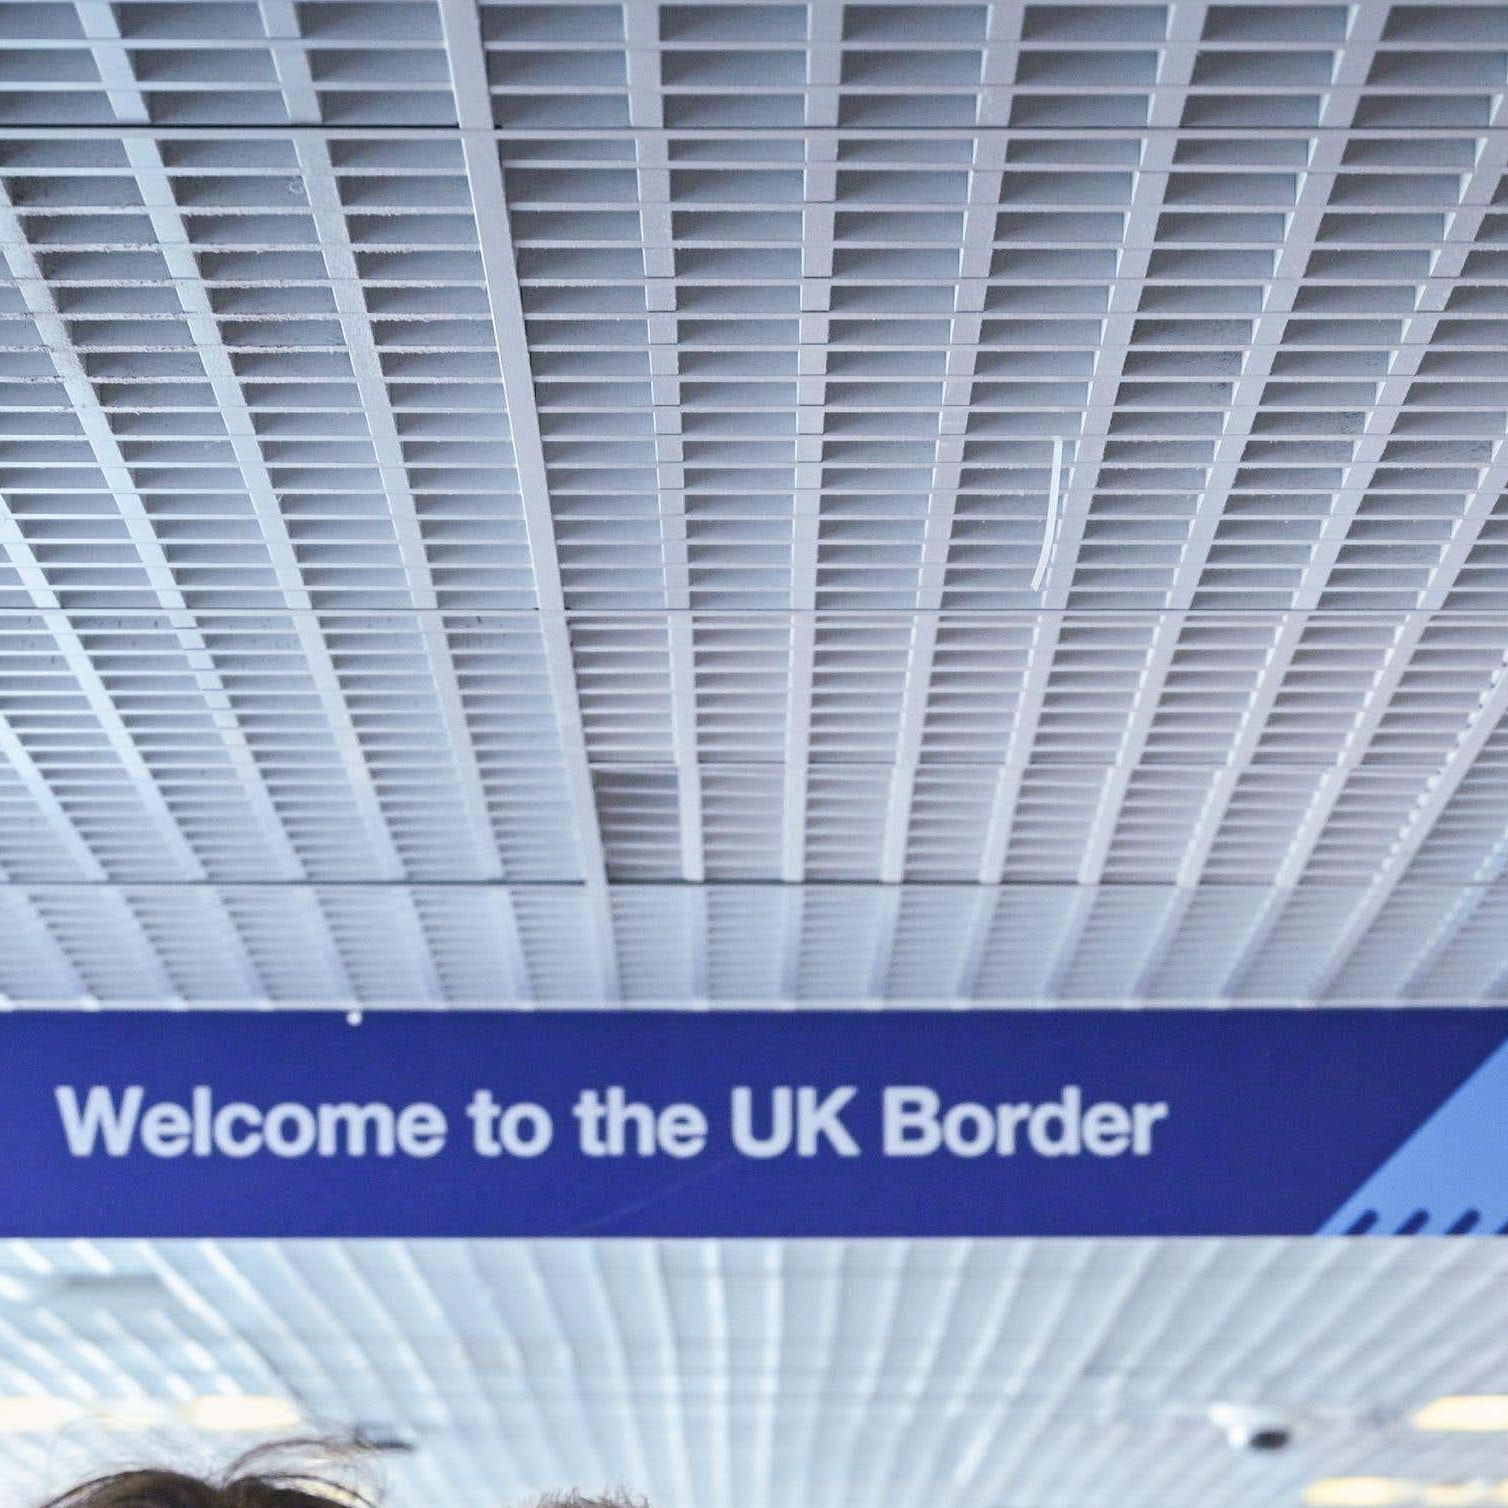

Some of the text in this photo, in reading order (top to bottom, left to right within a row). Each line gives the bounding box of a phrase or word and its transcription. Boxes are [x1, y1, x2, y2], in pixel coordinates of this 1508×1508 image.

[55, 1085, 1168, 1158] Welcome to the UK Border
